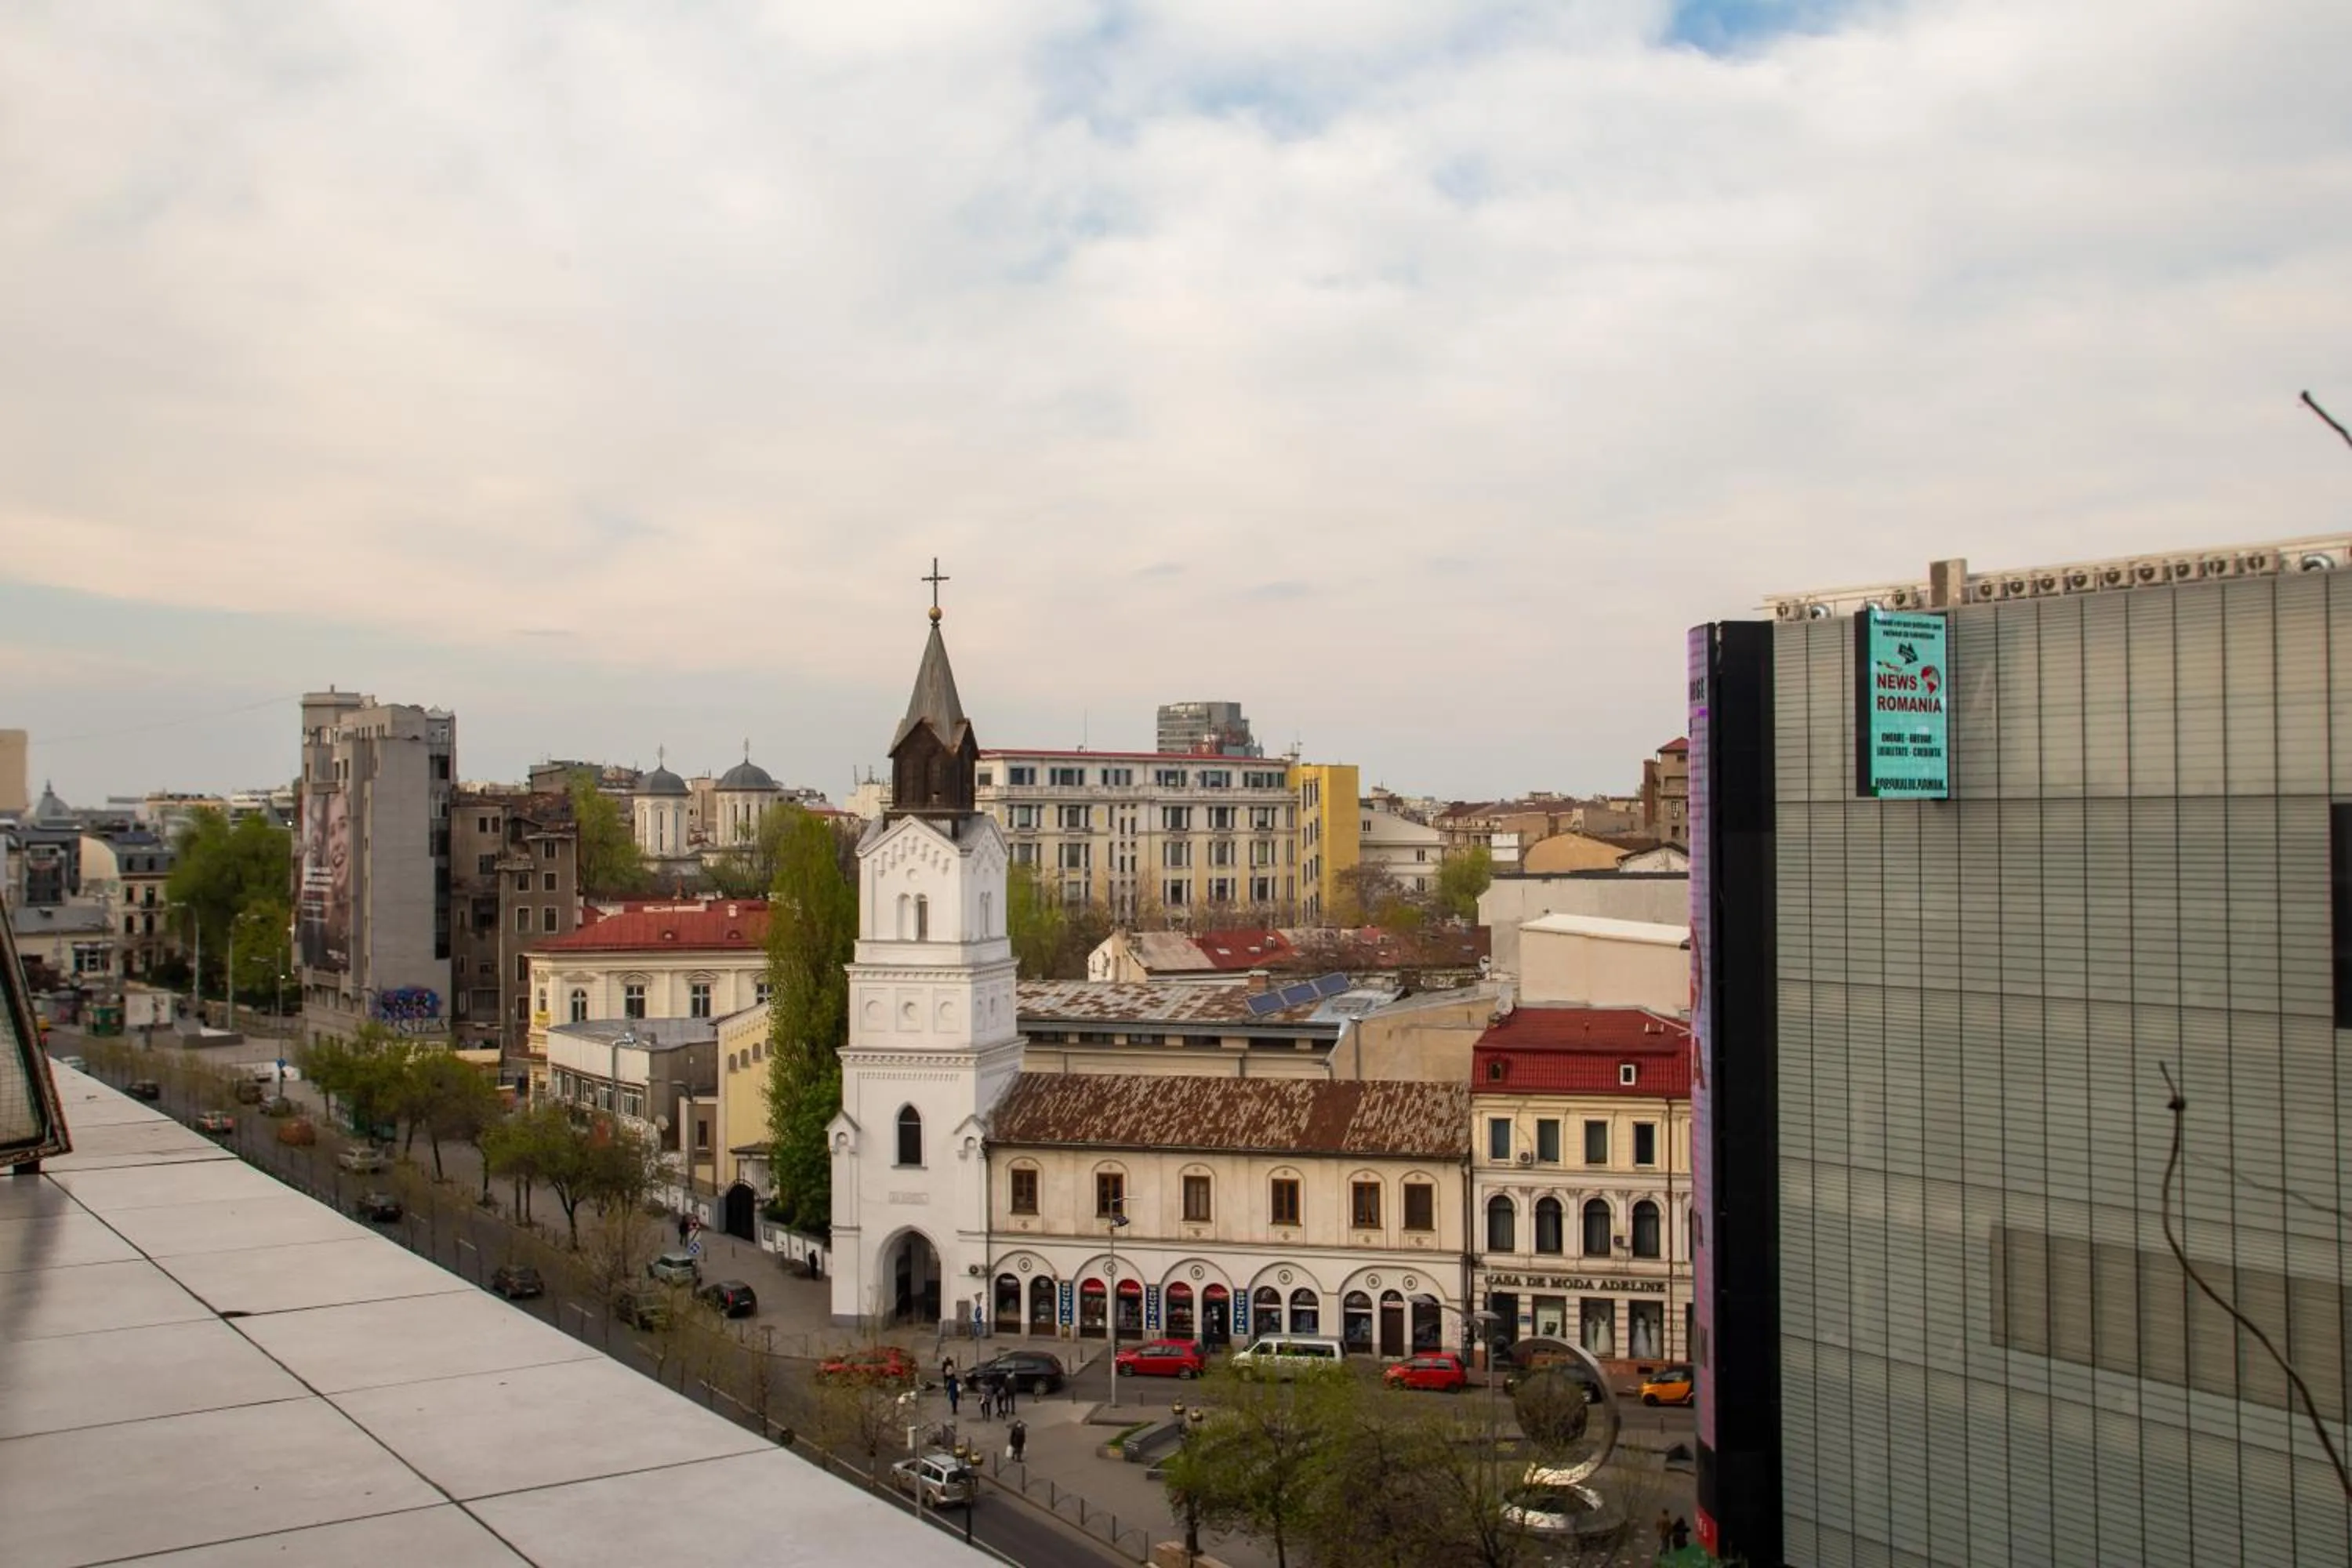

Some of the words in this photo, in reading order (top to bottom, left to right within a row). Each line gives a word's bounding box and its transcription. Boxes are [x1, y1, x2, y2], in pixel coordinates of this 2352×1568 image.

[1877, 673, 1918, 691] NEWS
[1877, 695, 1942, 713] ROMANIA
[1485, 1274, 1522, 1287] CASA
[1527, 1276, 1546, 1287] DE
[1550, 1277, 1594, 1290] MODA
[1599, 1279, 1666, 1293] ADELINE
